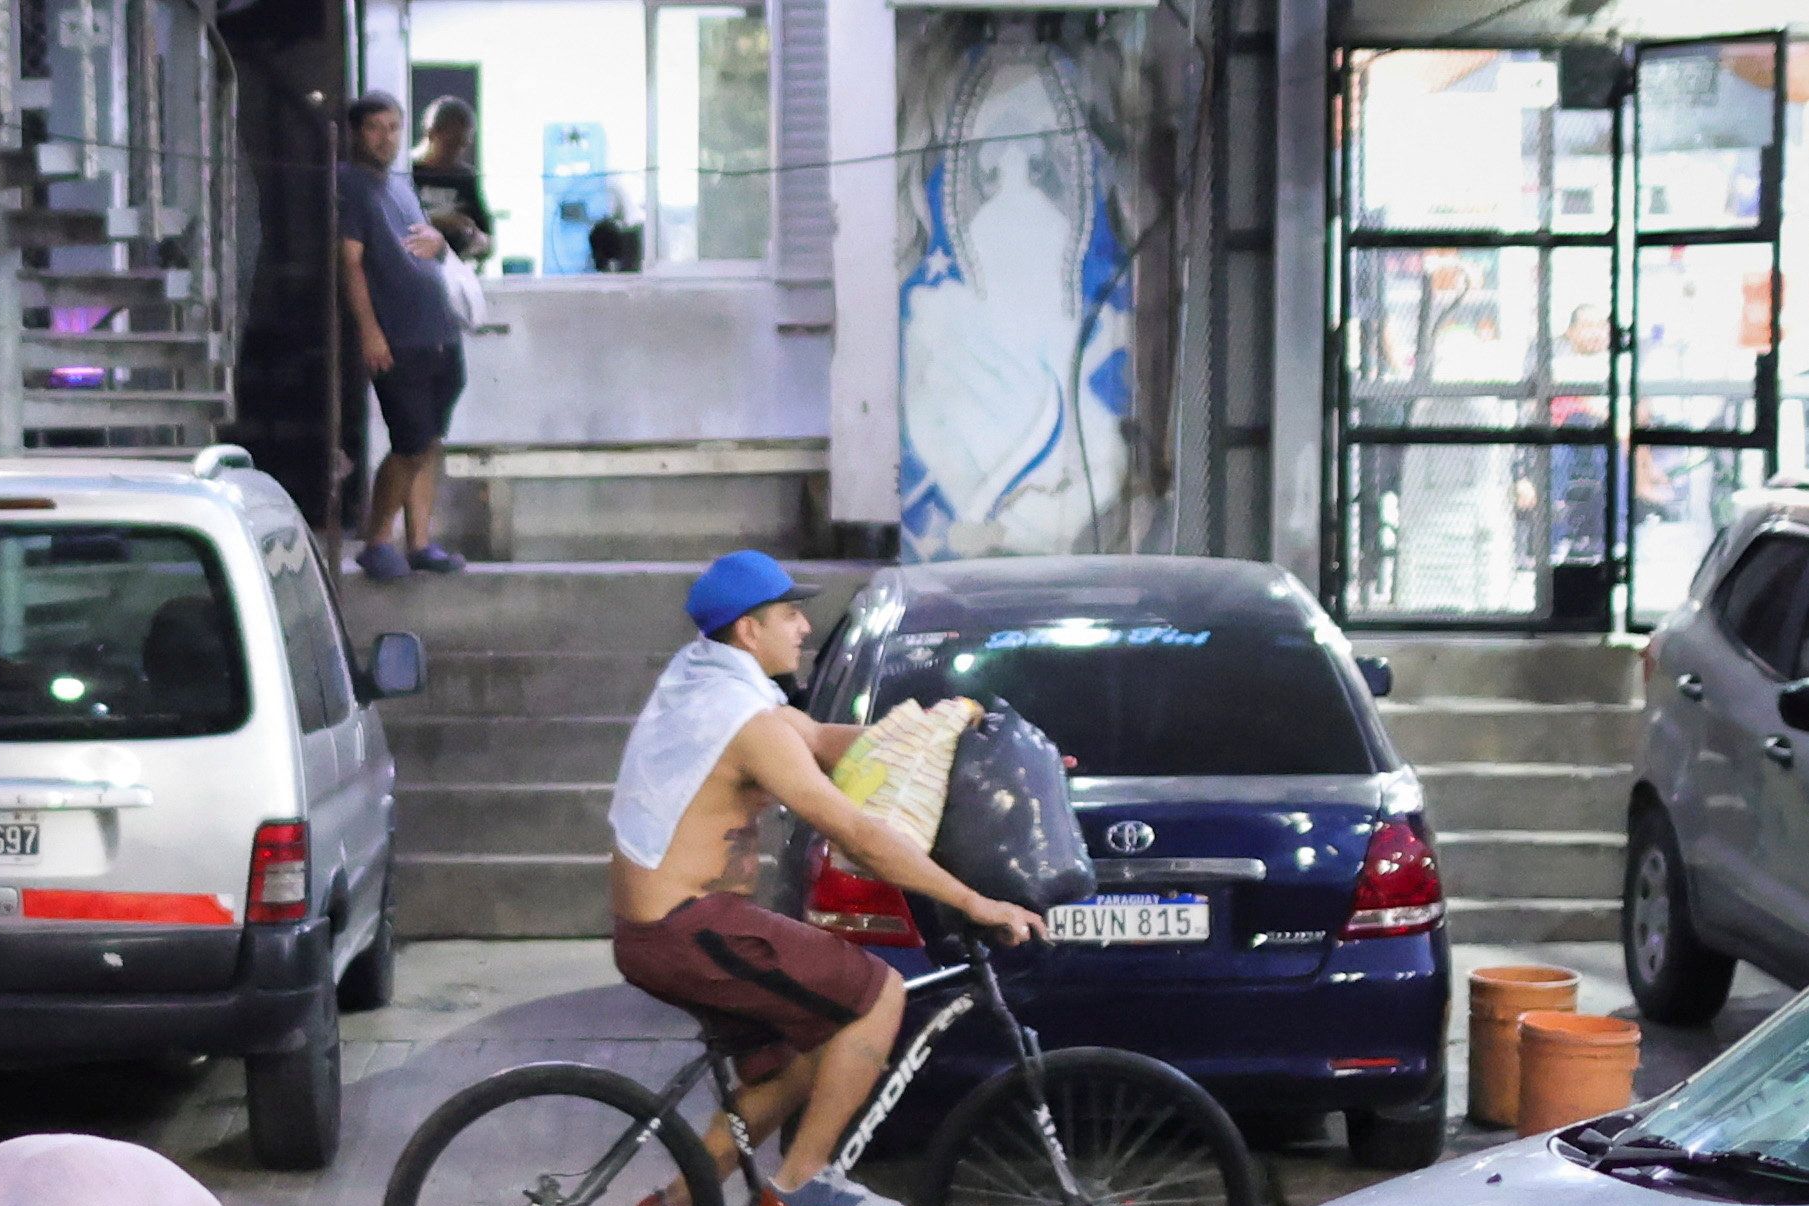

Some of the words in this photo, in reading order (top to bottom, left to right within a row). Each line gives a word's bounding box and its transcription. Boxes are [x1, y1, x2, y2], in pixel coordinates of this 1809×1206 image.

[1096, 894, 1161, 906] PARAGUAY
[1053, 908, 1127, 937] WBVN
[1137, 908, 1191, 936] 815
